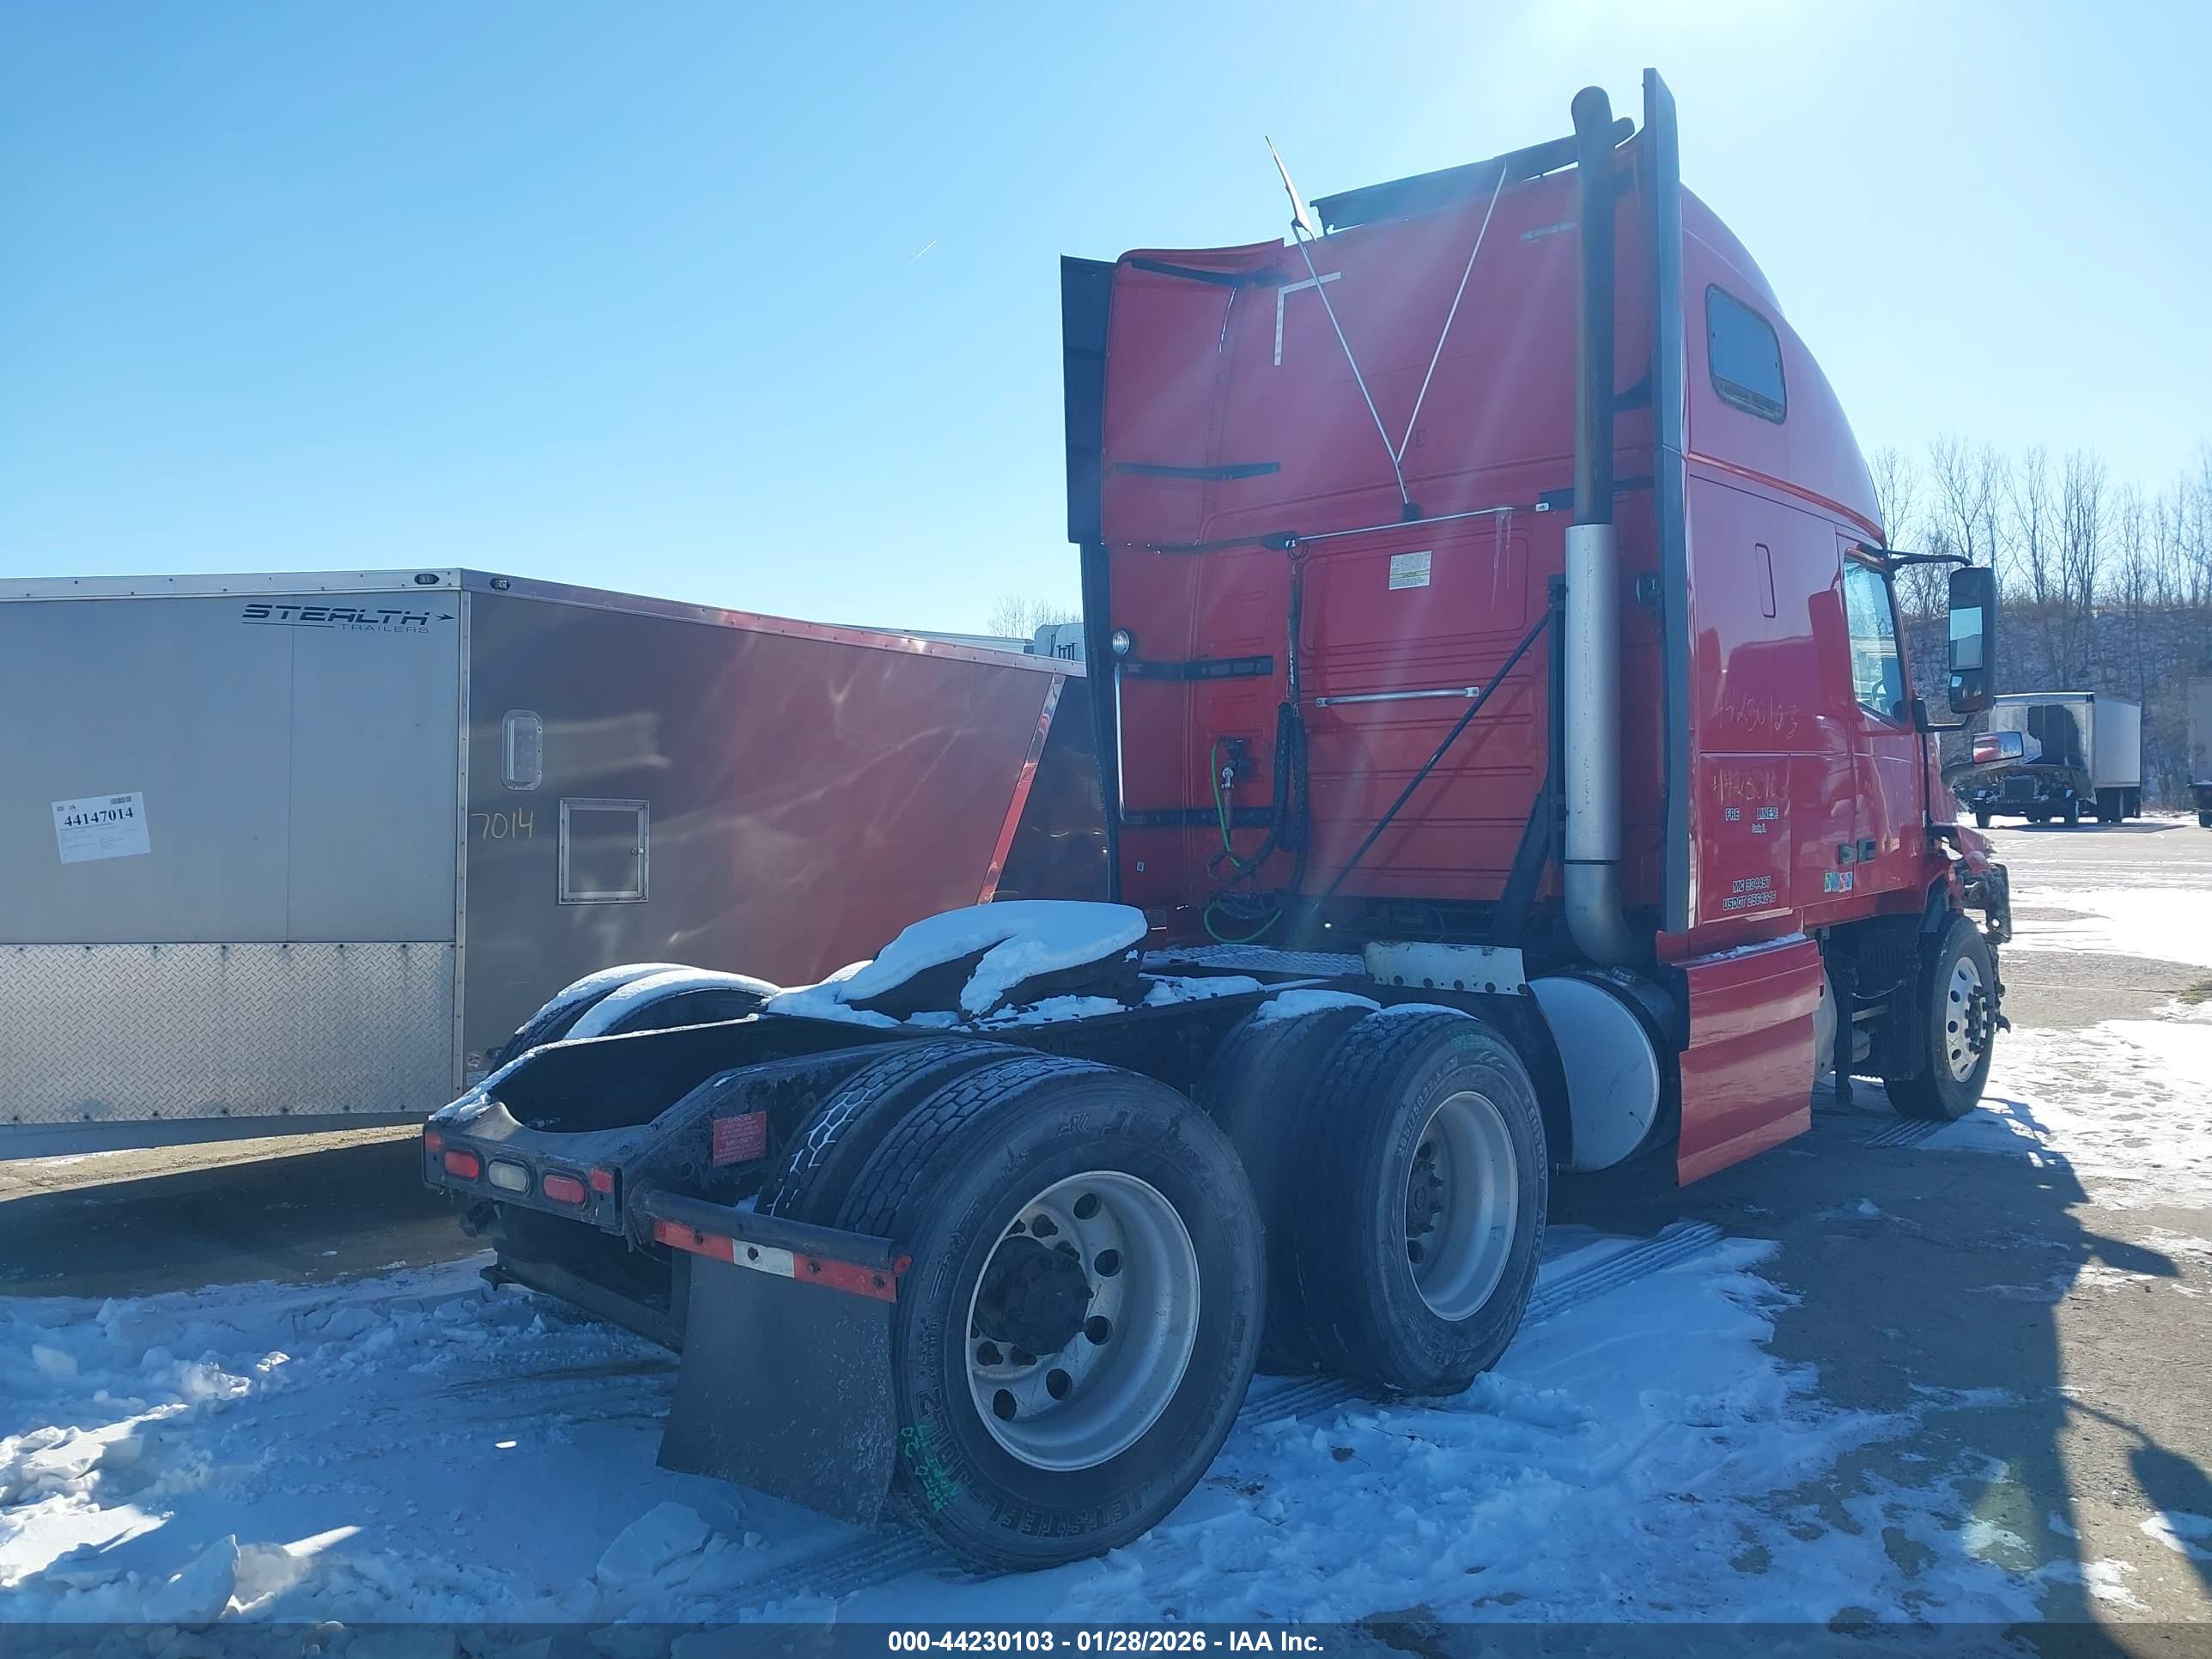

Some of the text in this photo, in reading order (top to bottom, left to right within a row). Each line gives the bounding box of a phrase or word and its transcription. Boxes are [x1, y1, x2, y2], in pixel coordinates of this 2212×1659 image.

[242, 604, 431, 625] STEALTH
[340, 623, 430, 634] TRAILERS
[64, 807, 133, 826] 44147014
[470, 806, 533, 840] 7014
[1723, 896, 1747, 910] USDOT
